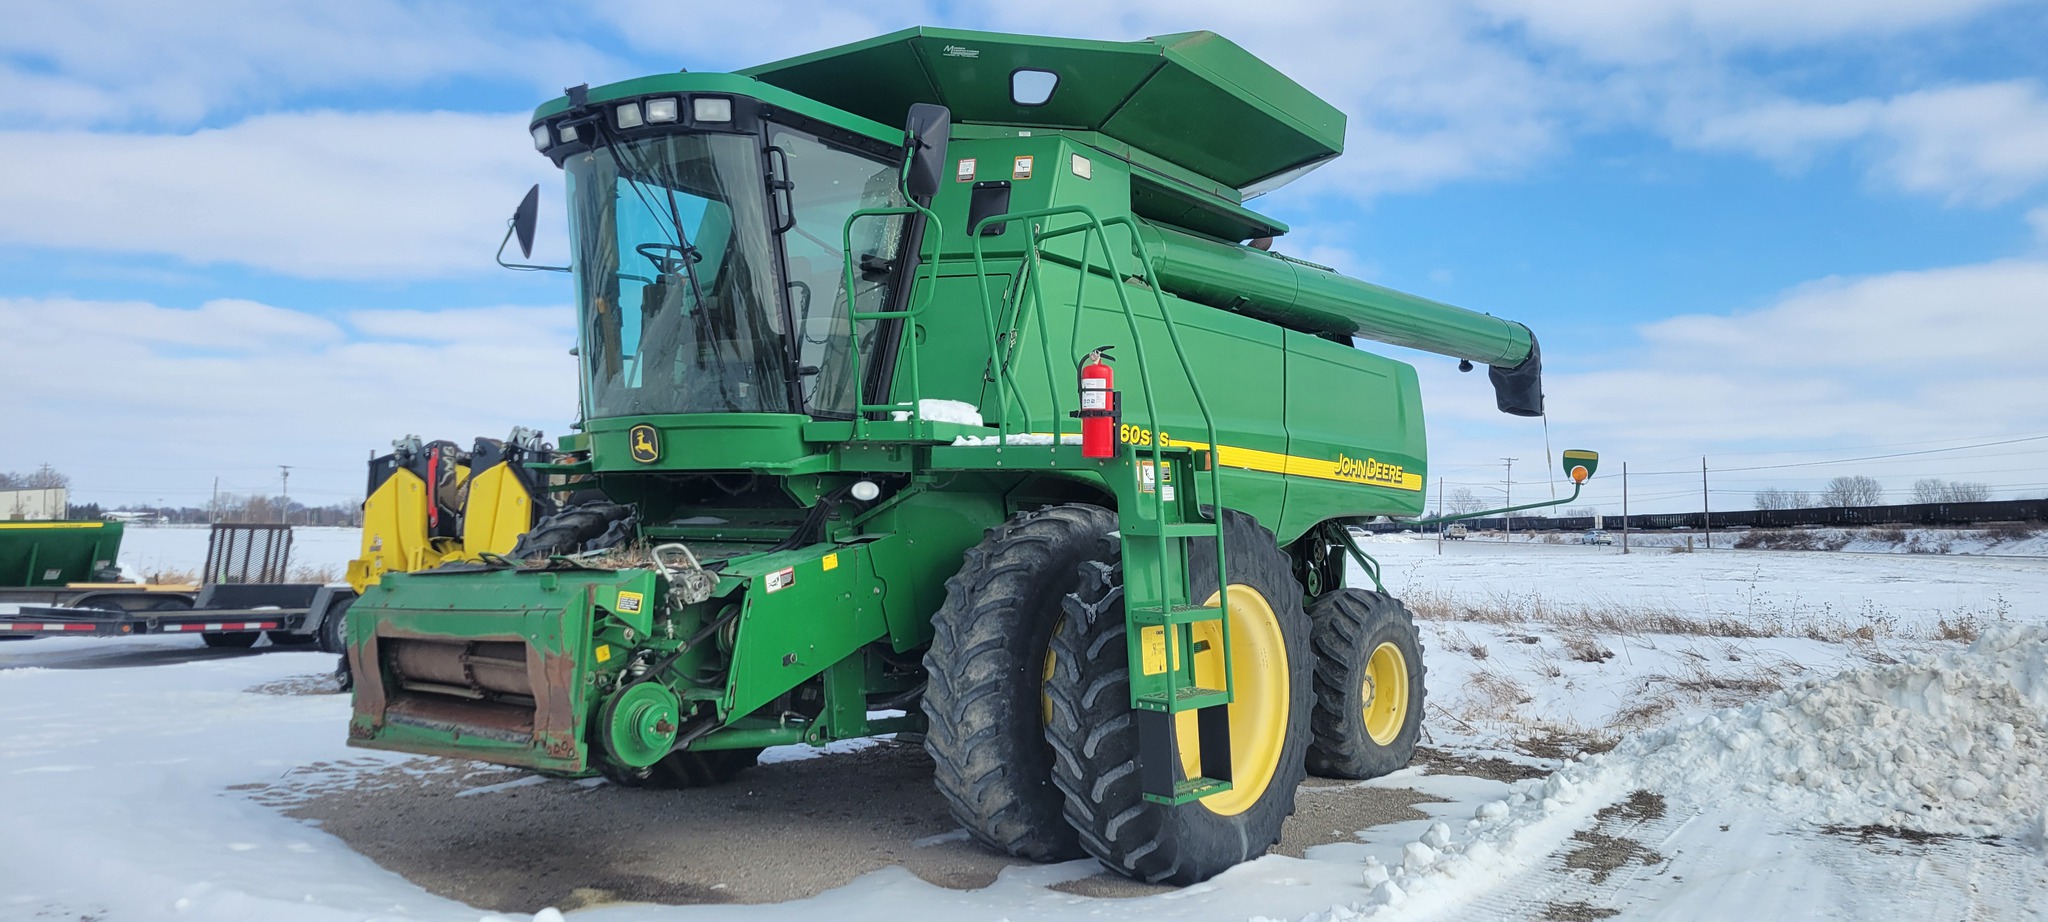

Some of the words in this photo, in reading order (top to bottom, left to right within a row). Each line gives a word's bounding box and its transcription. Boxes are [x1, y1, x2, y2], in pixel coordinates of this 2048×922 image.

[1121, 424, 1169, 447] 60SS
[1334, 453, 1367, 478] JOHN
[1367, 457, 1403, 483] DEERE
